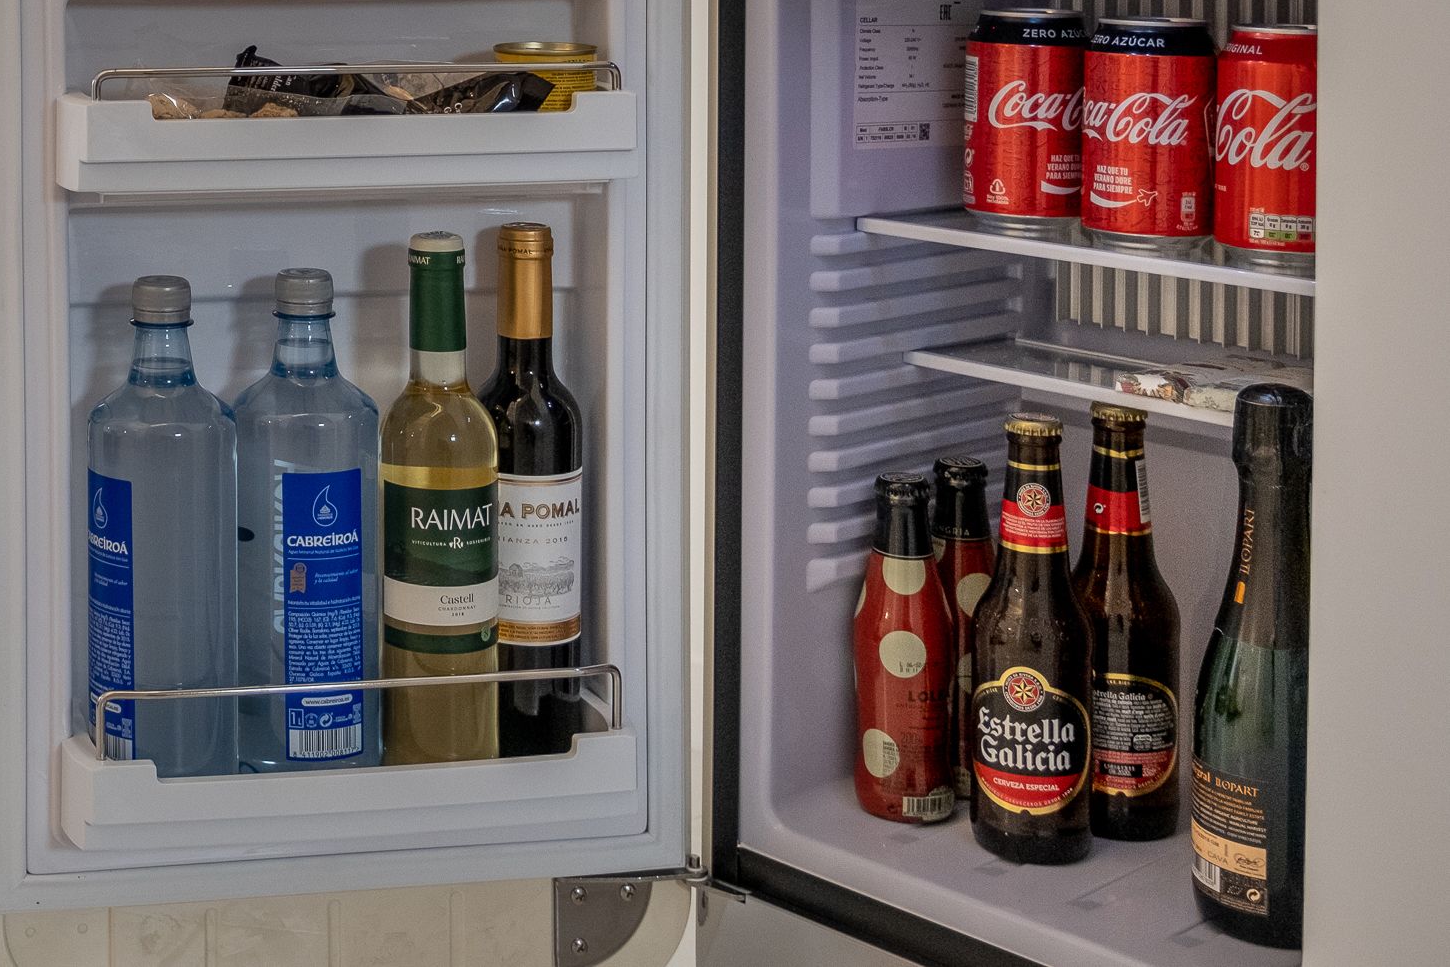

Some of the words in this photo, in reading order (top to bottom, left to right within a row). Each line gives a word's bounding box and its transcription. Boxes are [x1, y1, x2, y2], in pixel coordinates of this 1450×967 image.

[1023, 29, 1056, 39] ZERO
[1111, 35, 1165, 48] AZÚCAR
[988, 80, 1085, 131] Coca-C
[1083, 92, 1198, 146] ca-Cola
[1120, 167, 1129, 176] TU
[1106, 184, 1133, 194] SIEMPRE
[521, 498, 580, 520] POMAL
[411, 503, 493, 531] RAIMAT
[88, 531, 128, 555] BREIROÁ
[287, 529, 359, 547] CABREIROÁ
[412, 539, 446, 547] VITICULTURA
[440, 593, 474, 605] Castell
[505, 594, 552, 606] RIOJA
[1118, 692, 1146, 701] Galicia
[978, 706, 1075, 744] Estrella
[981, 735, 1071, 771] Galicia
[993, 777, 1025, 790] CERVEZA
[1025, 783, 1060, 791] ESPECIAL
